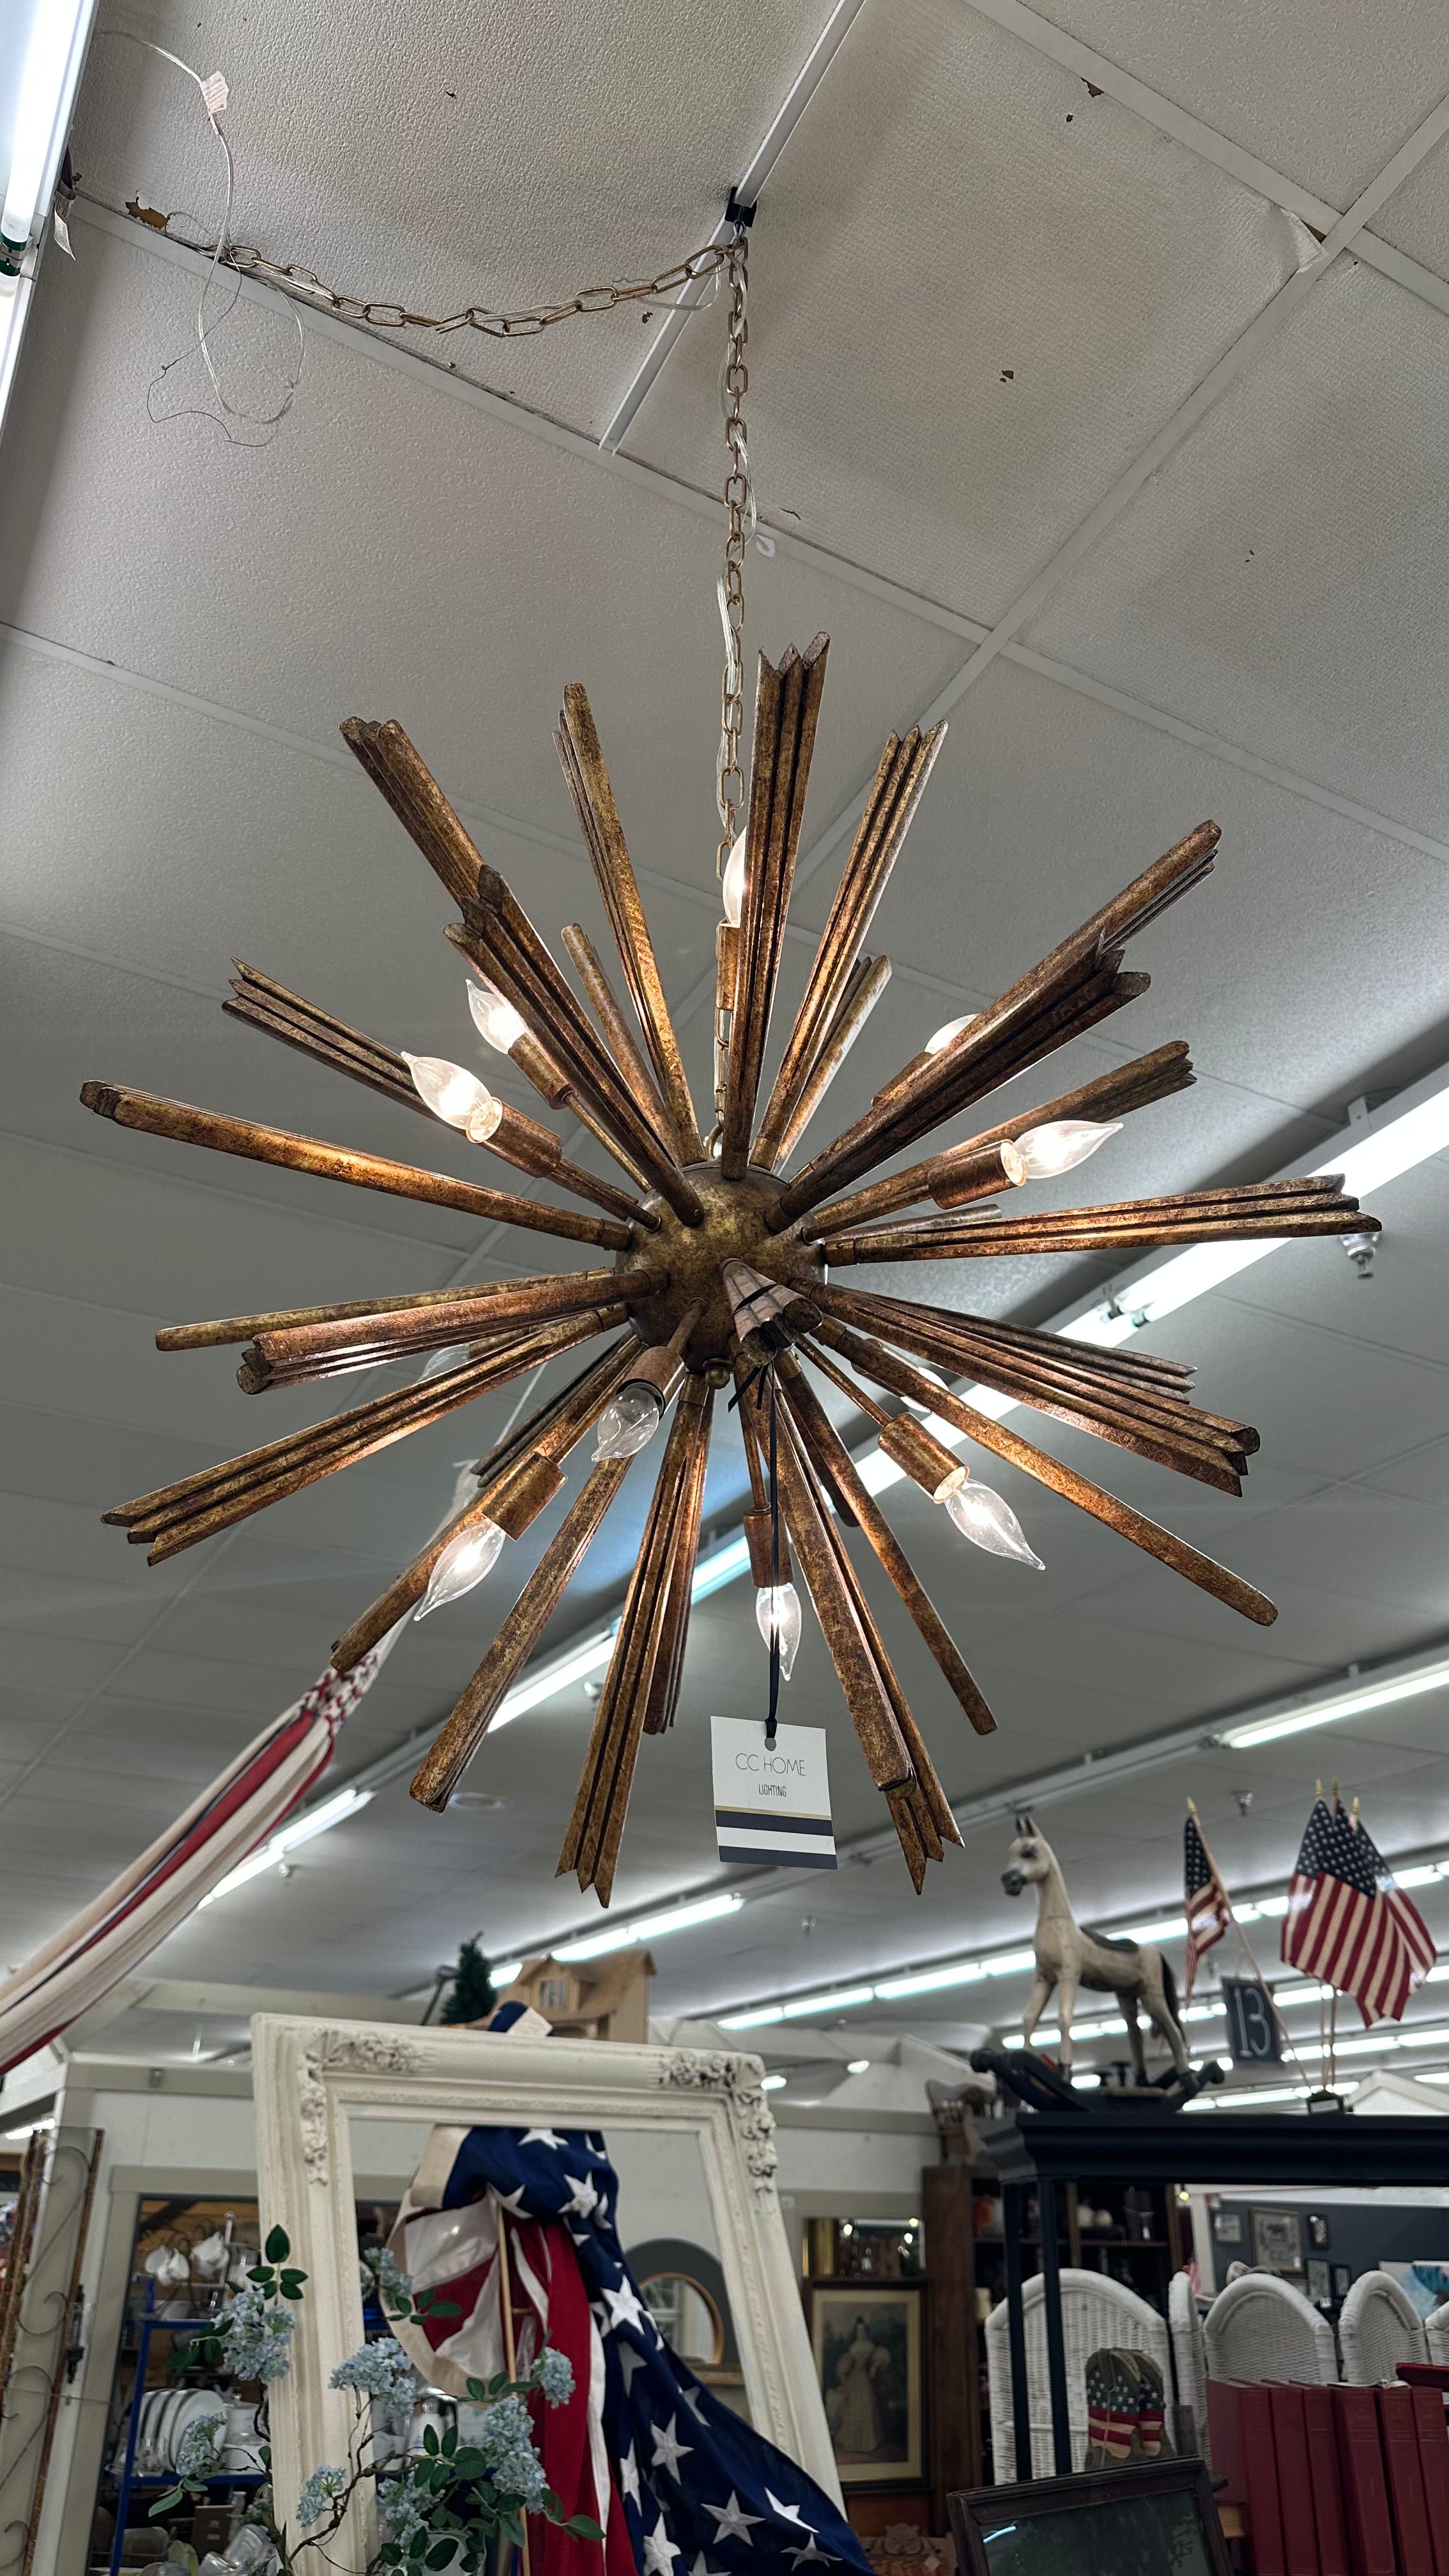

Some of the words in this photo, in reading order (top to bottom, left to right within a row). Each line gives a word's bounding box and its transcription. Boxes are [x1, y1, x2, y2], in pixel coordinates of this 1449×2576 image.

[735, 1752, 760, 1771] CC
[763, 1756, 806, 1776] HOME
[758, 1783, 787, 1797] LIGHTING
[1234, 1986, 1271, 2057] 13
